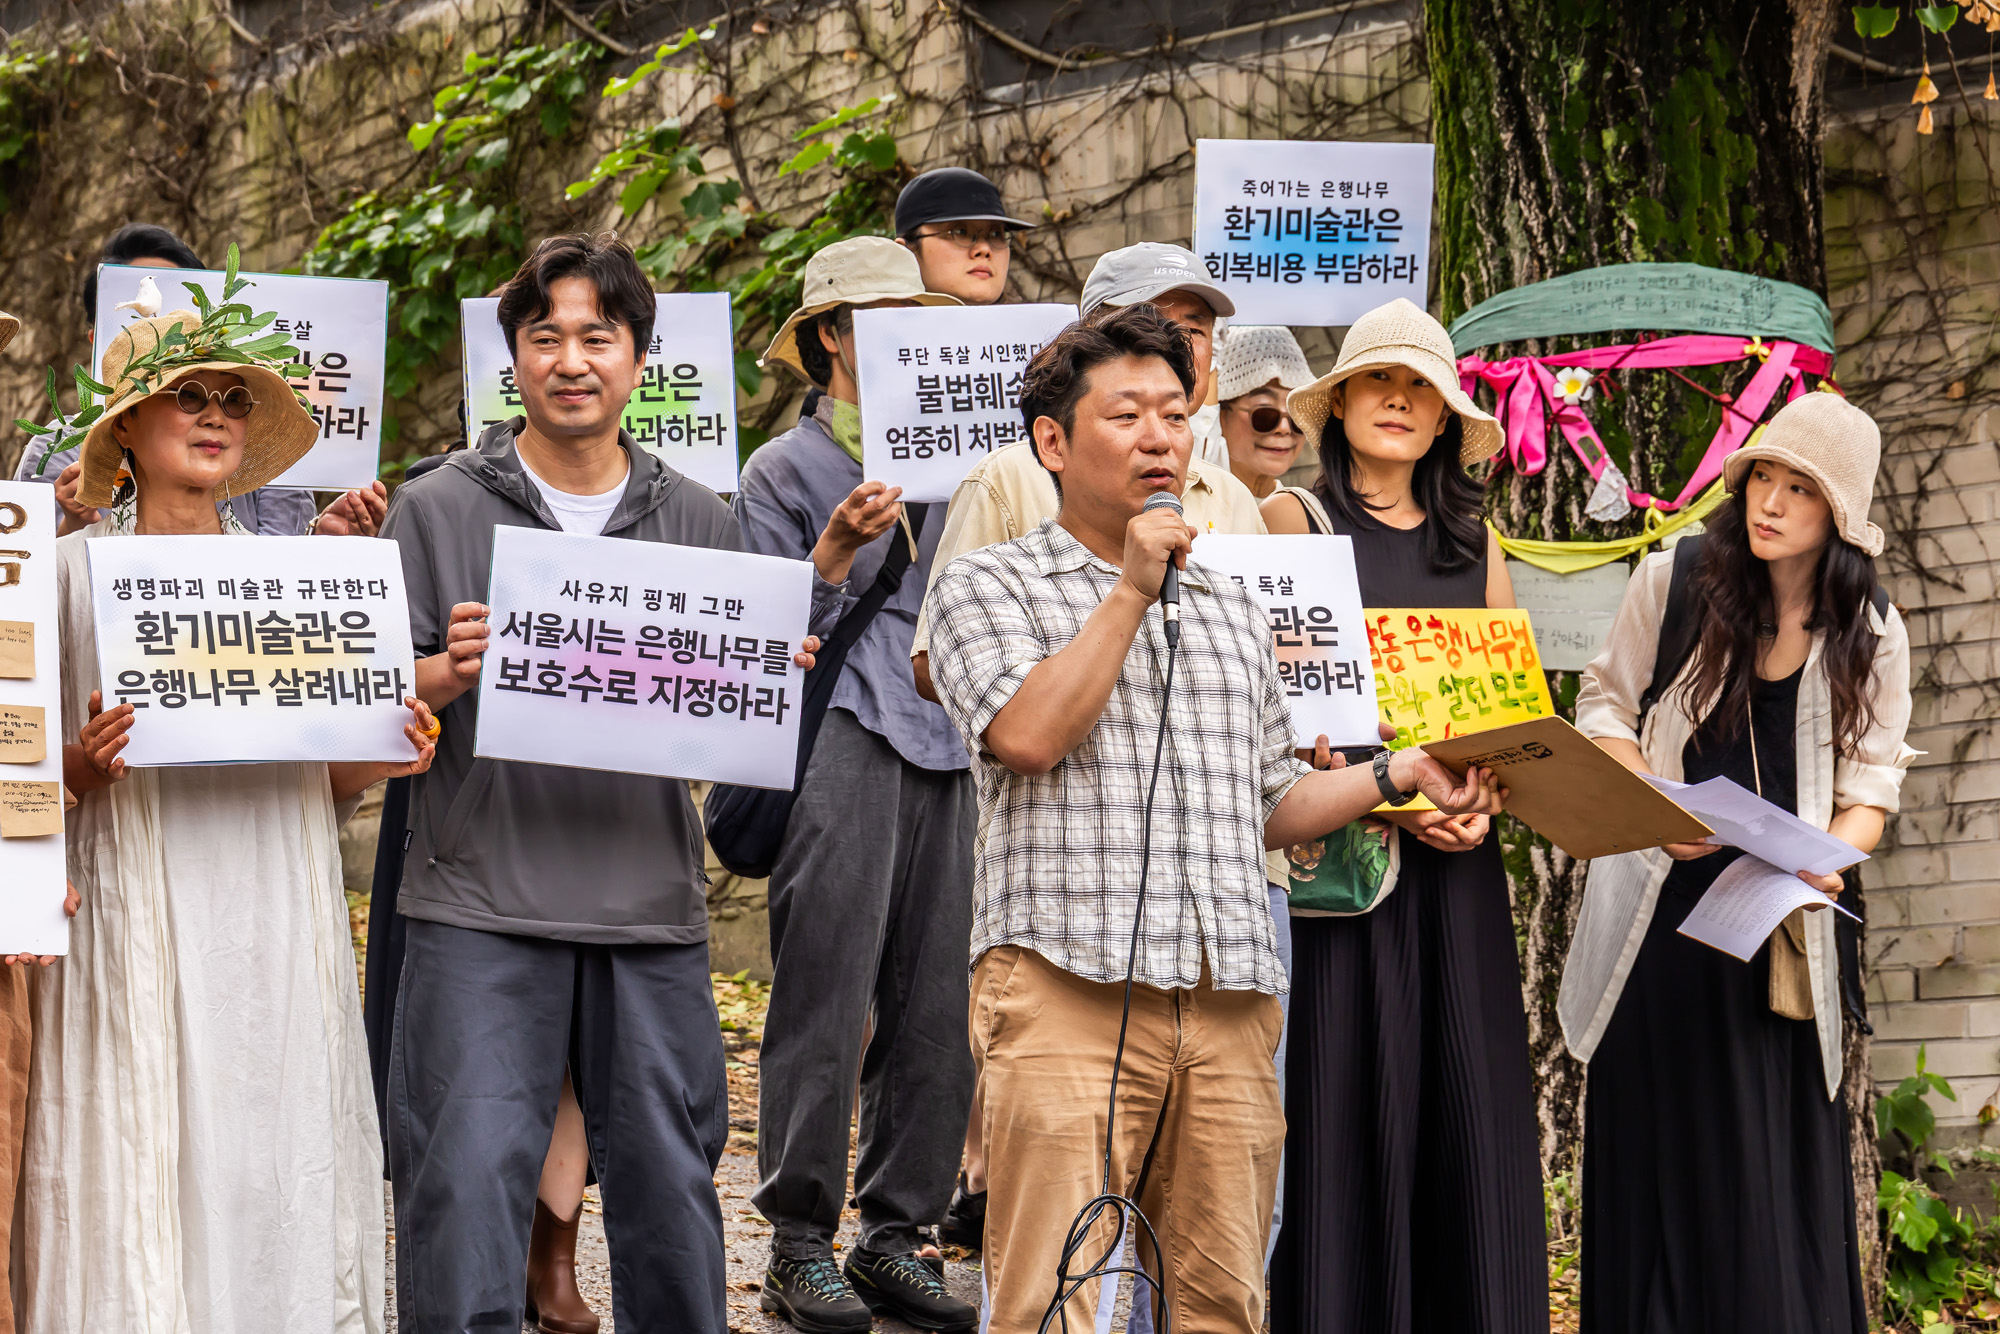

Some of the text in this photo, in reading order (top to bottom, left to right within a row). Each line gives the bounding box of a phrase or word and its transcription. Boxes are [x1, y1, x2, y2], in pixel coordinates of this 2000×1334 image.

[1242, 179, 1389, 199] 죽어가는 은행나무
[1224, 205, 1403, 243] 환기미술관은
[1204, 252, 1419, 284] 회복비용 부담하라
[898, 347, 929, 366] 무단
[939, 346, 970, 365] 독살
[886, 424, 961, 459] 엄중히
[113, 578, 388, 600] 생명파괴 미술관 규탄한다
[560, 580, 744, 620] 사유지 핑계 그만
[1258, 576, 1294, 596] 독살
[134, 610, 376, 655] 환기미술관은
[500, 611, 791, 676] 서울시는 은행나무를
[115, 668, 407, 708] 은행나무 살려내라
[495, 657, 790, 725] 보호수로 지정하라
